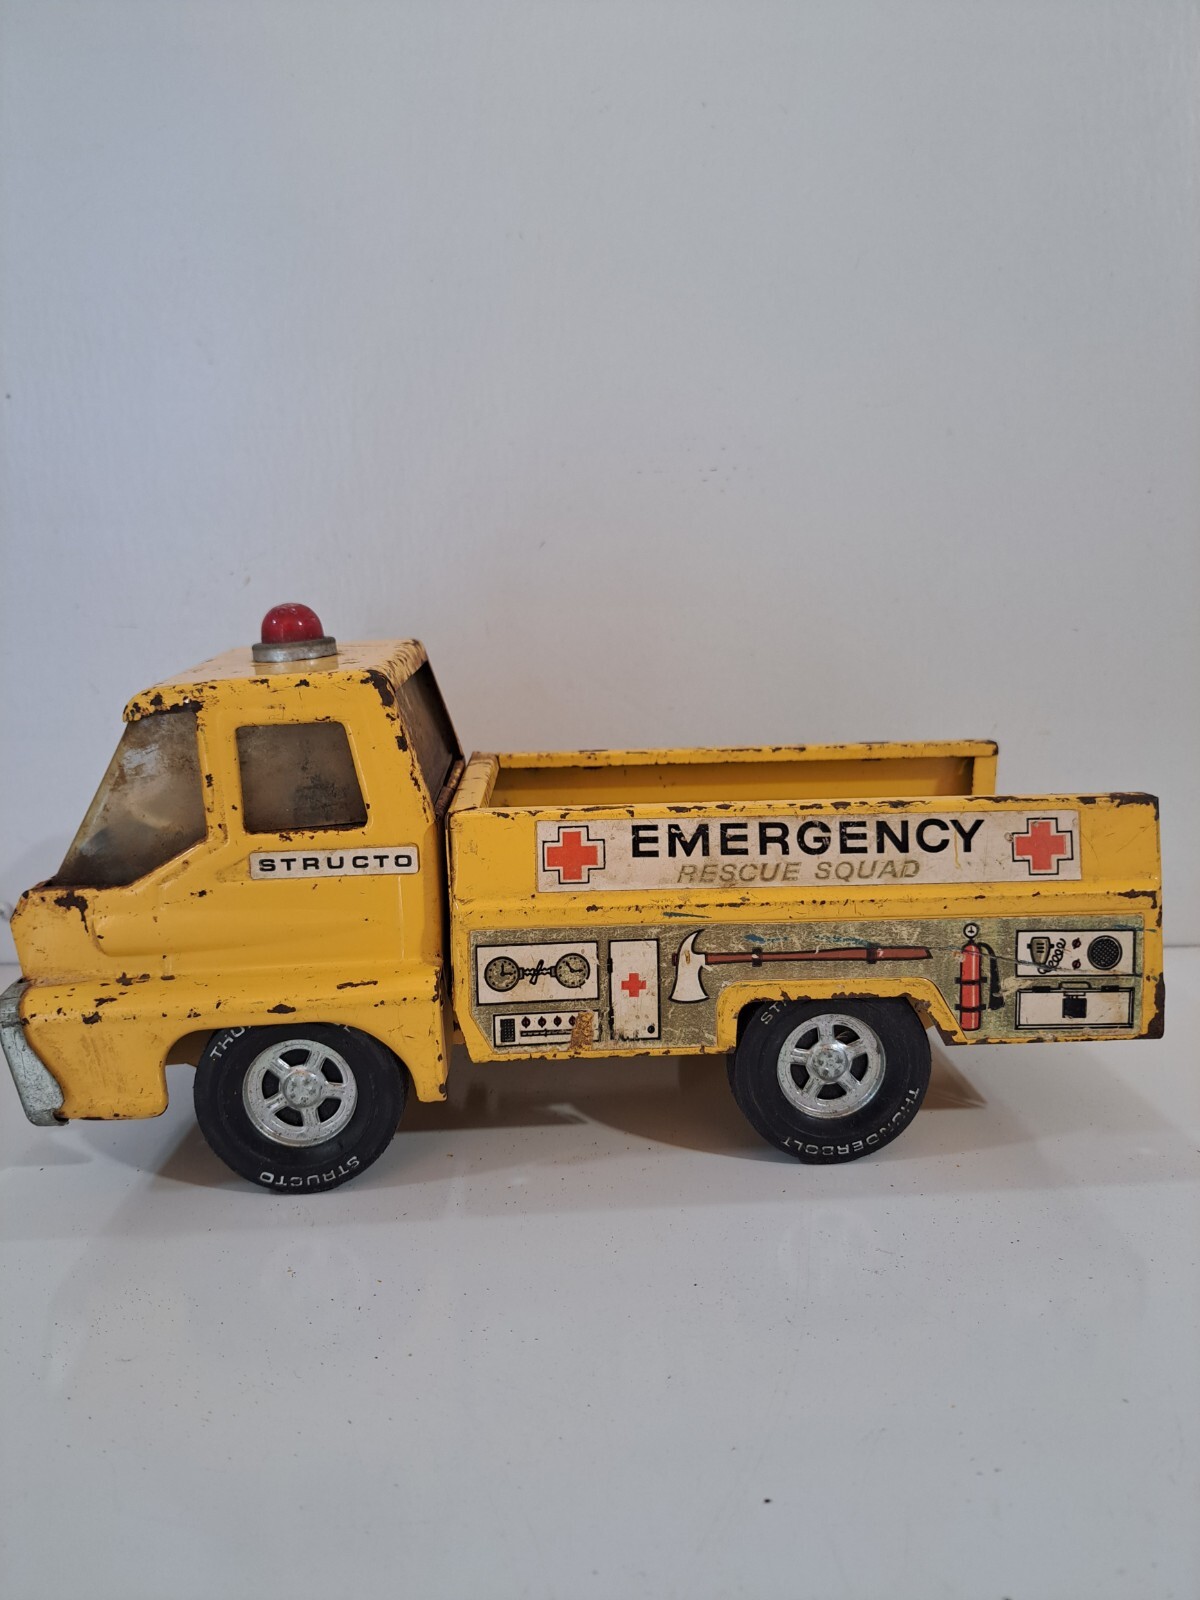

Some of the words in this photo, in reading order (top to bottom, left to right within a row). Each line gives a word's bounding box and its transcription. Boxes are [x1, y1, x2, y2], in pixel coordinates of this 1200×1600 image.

[631, 818, 985, 858] EMERGENCY
[259, 854, 412, 872] STRUCTO
[677, 862, 802, 884] RESCUE
[814, 859, 920, 882] SQUAD
[760, 1001, 787, 1025] ST
[209, 1025, 251, 1058] THU
[259, 1155, 360, 1187] STRUCTO
